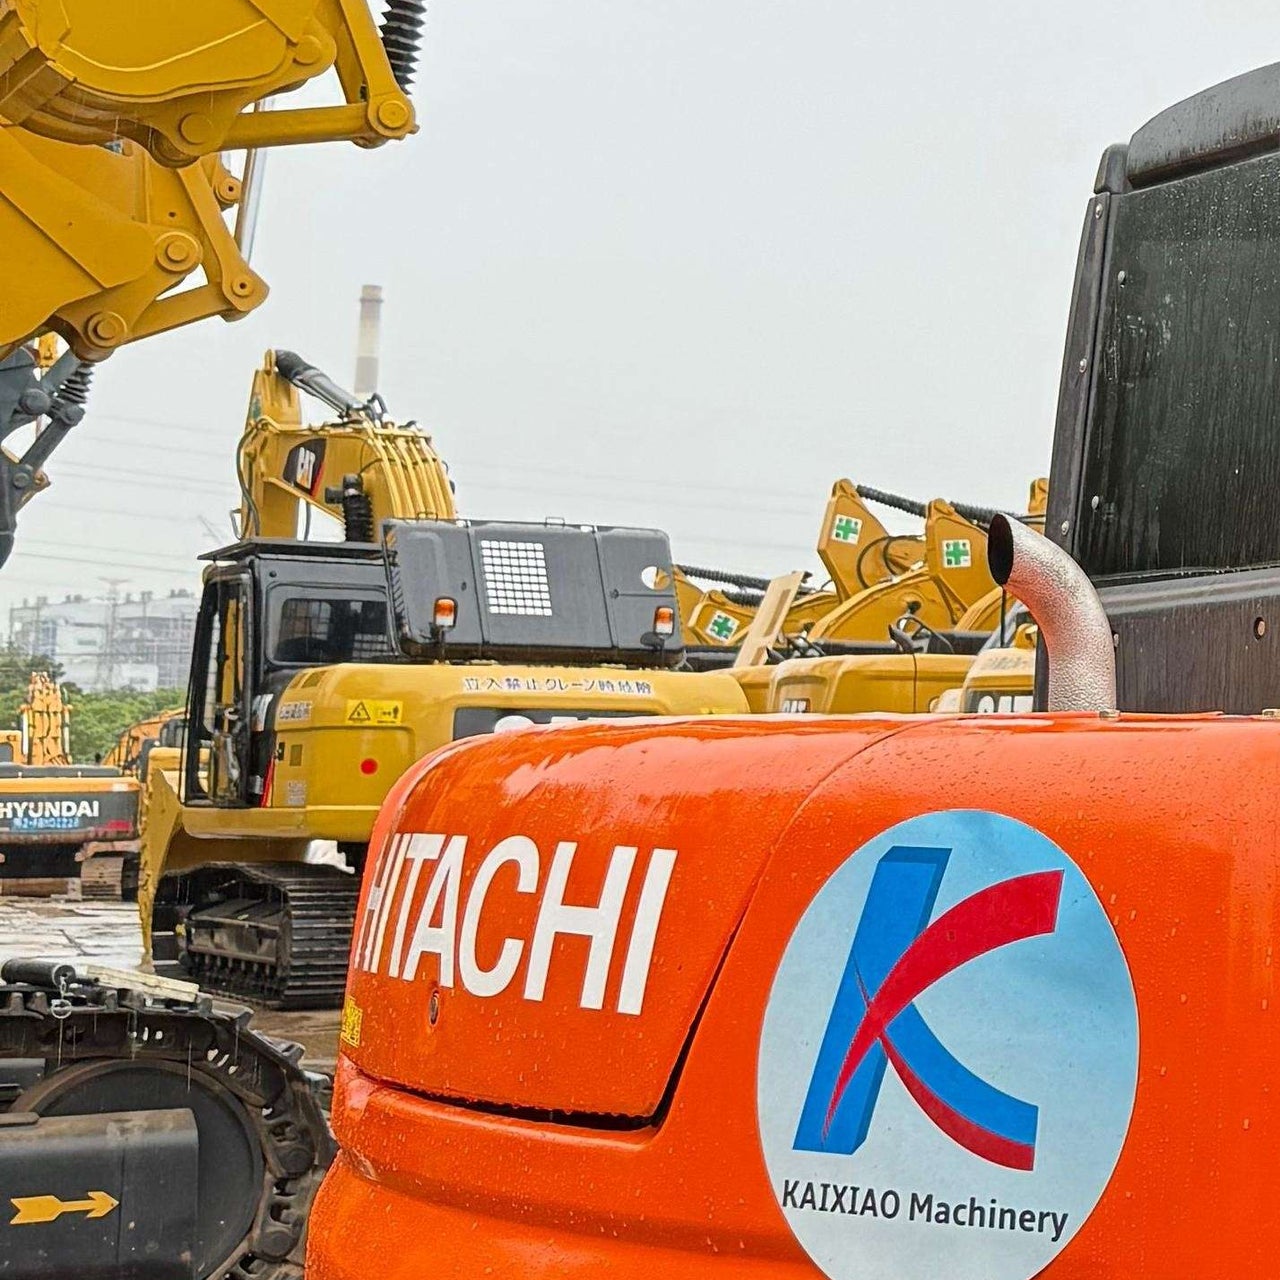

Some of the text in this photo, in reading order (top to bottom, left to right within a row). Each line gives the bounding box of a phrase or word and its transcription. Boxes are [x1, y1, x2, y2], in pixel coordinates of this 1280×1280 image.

[0, 801, 99, 818] HYUNDAI
[353, 833, 678, 1016] HITACHI
[782, 1179, 1069, 1242] KAIXIAO Machinery
